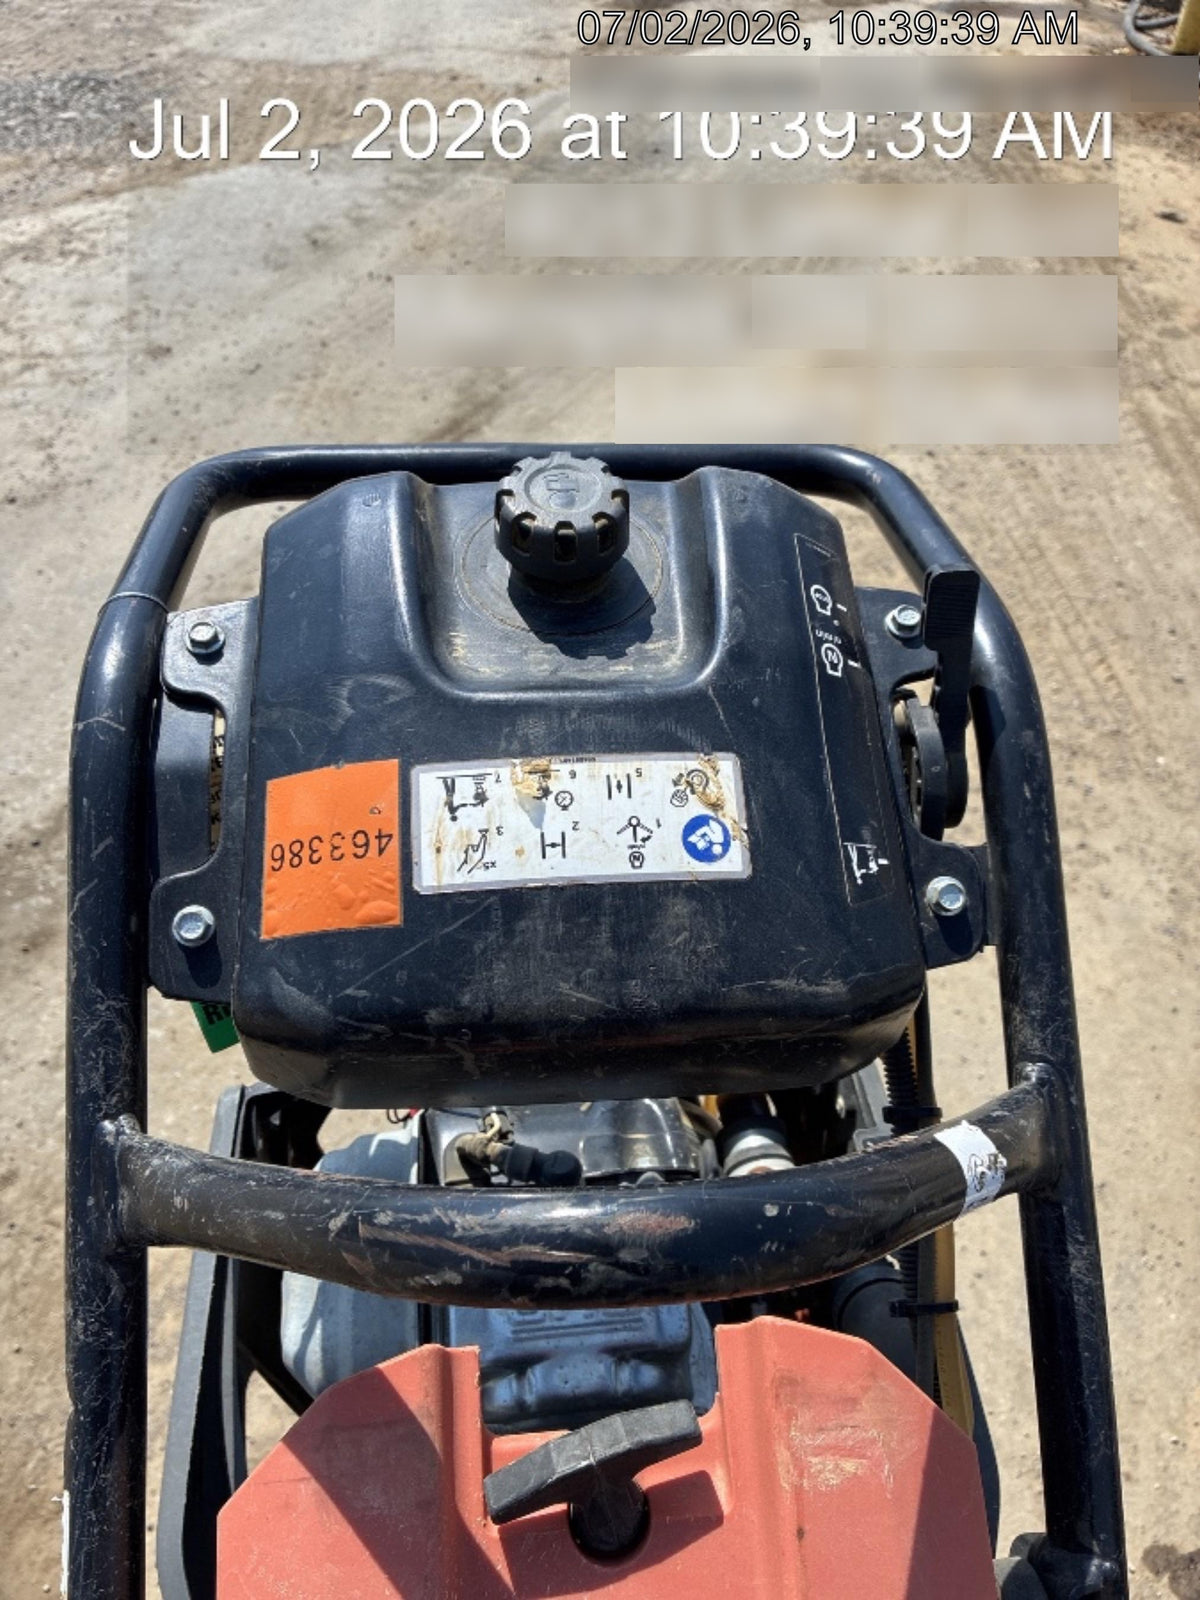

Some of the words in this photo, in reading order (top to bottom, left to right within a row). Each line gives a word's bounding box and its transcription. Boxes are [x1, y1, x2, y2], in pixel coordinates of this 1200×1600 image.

[569, 770, 577, 779] 6
[634, 768, 643, 777] 5
[495, 826, 504, 836] 3
[571, 821, 580, 831] 2
[271, 828, 393, 872] 463386
